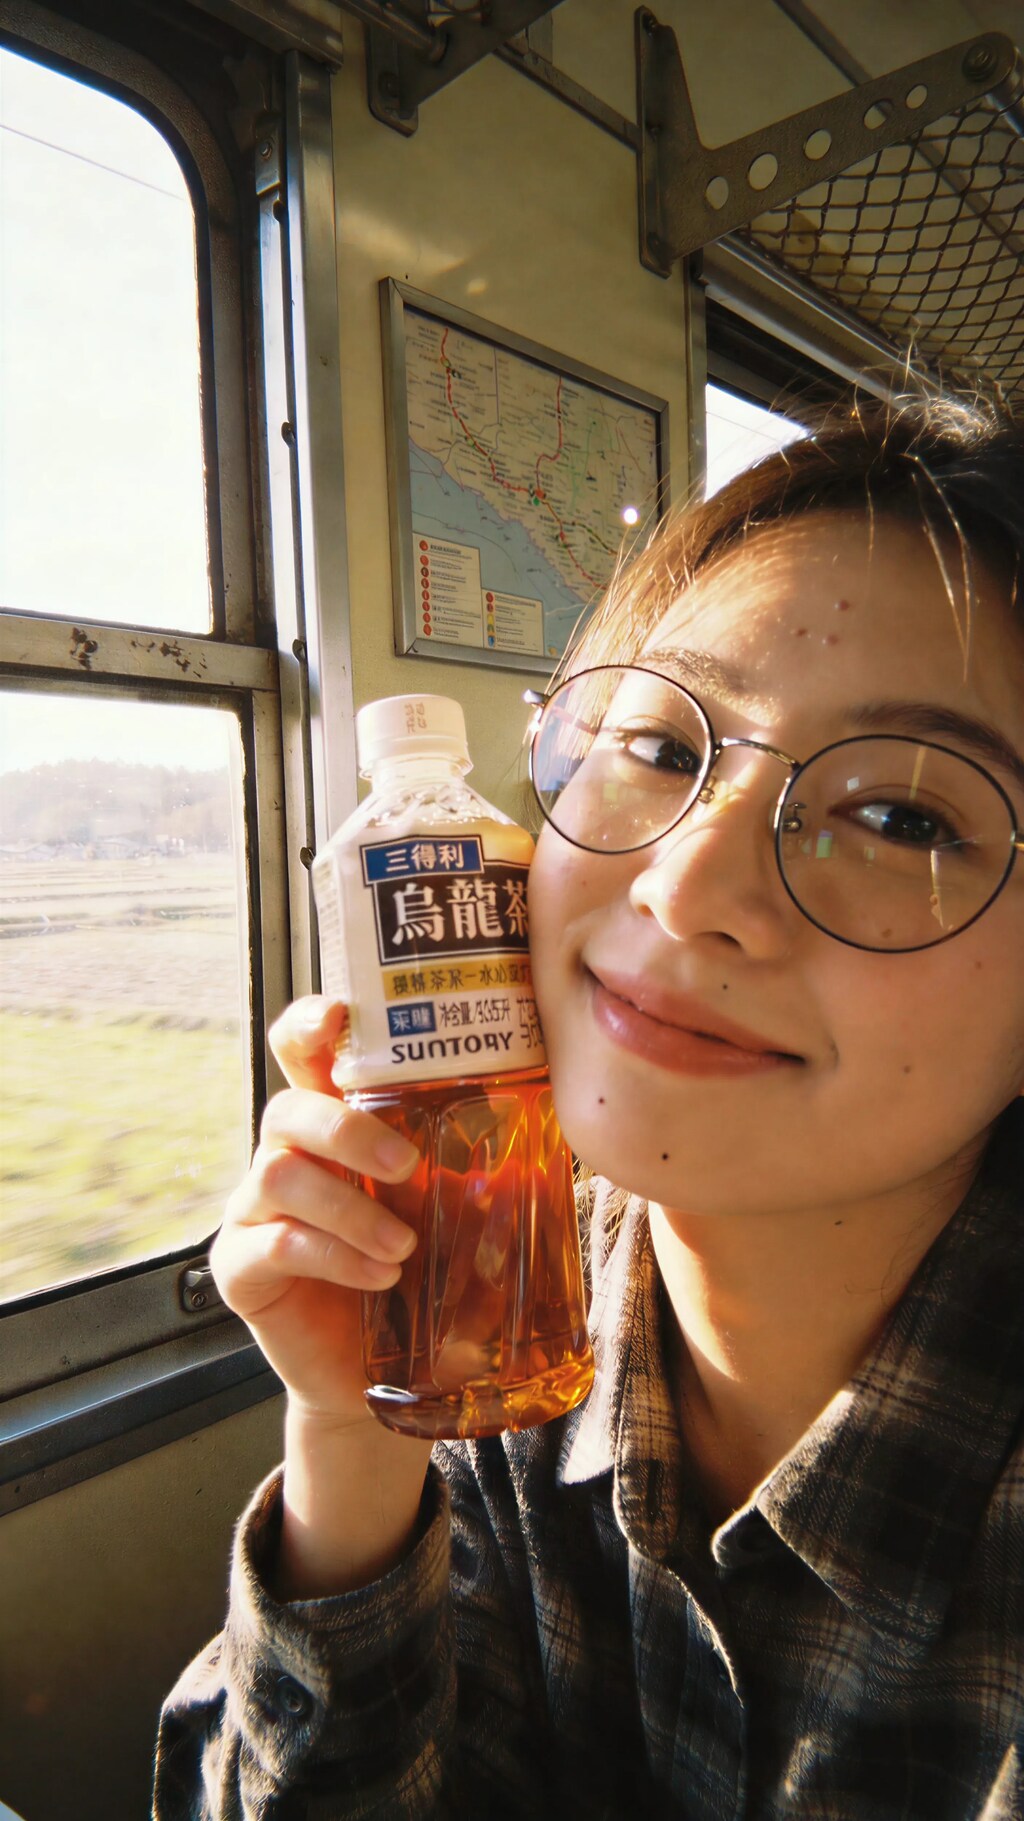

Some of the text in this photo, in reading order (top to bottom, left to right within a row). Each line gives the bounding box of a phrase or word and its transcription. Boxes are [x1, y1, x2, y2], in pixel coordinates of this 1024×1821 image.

[385, 842, 465, 872] 三得利
[391, 877, 529, 946] 烏龍茶
